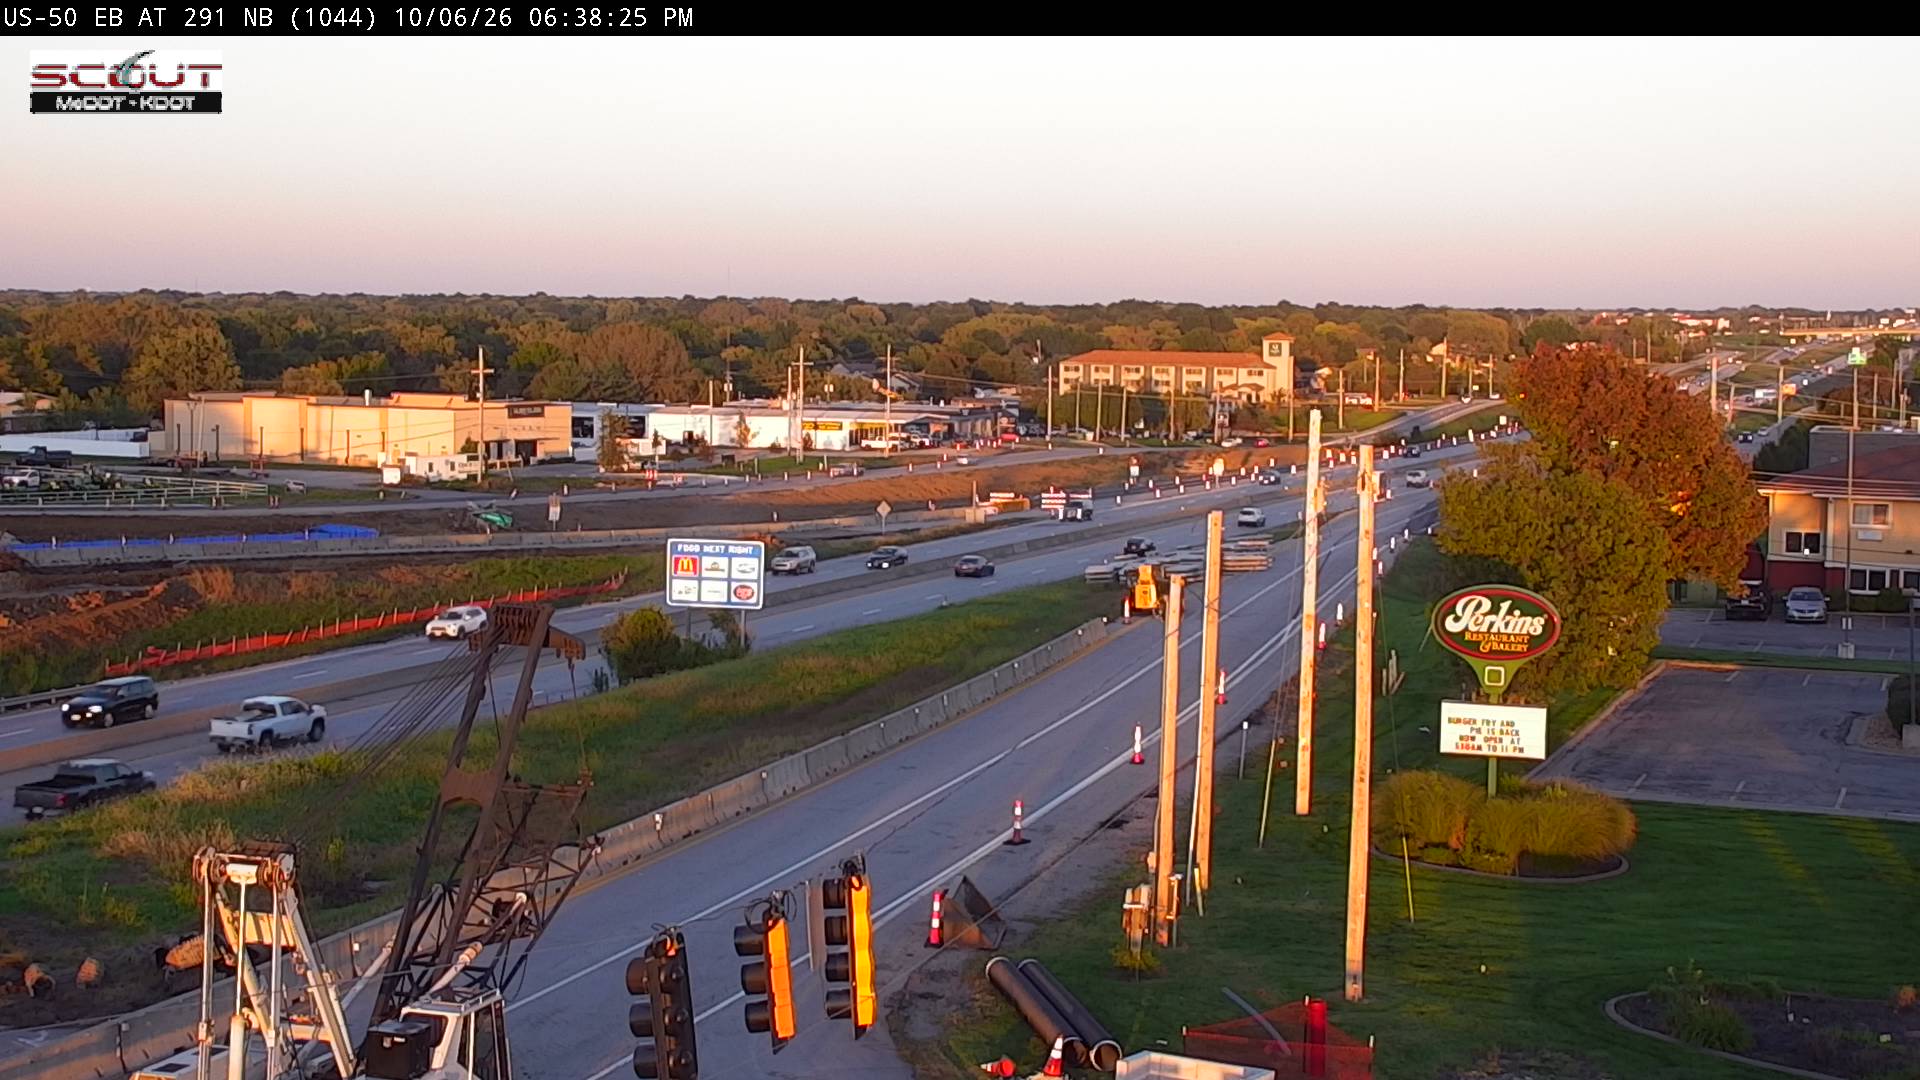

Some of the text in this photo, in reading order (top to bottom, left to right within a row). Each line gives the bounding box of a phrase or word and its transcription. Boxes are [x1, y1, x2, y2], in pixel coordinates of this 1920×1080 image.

[677, 544, 753, 555] FOOD NEXT RIGHT
[1445, 595, 1545, 635] Perkins
[1500, 720, 1515, 728] AND
[1499, 728, 1520, 737] BACK
[1483, 736, 1503, 744] OPEN
[1487, 744, 1498, 753] TO
[1512, 746, 1525, 754] PM
